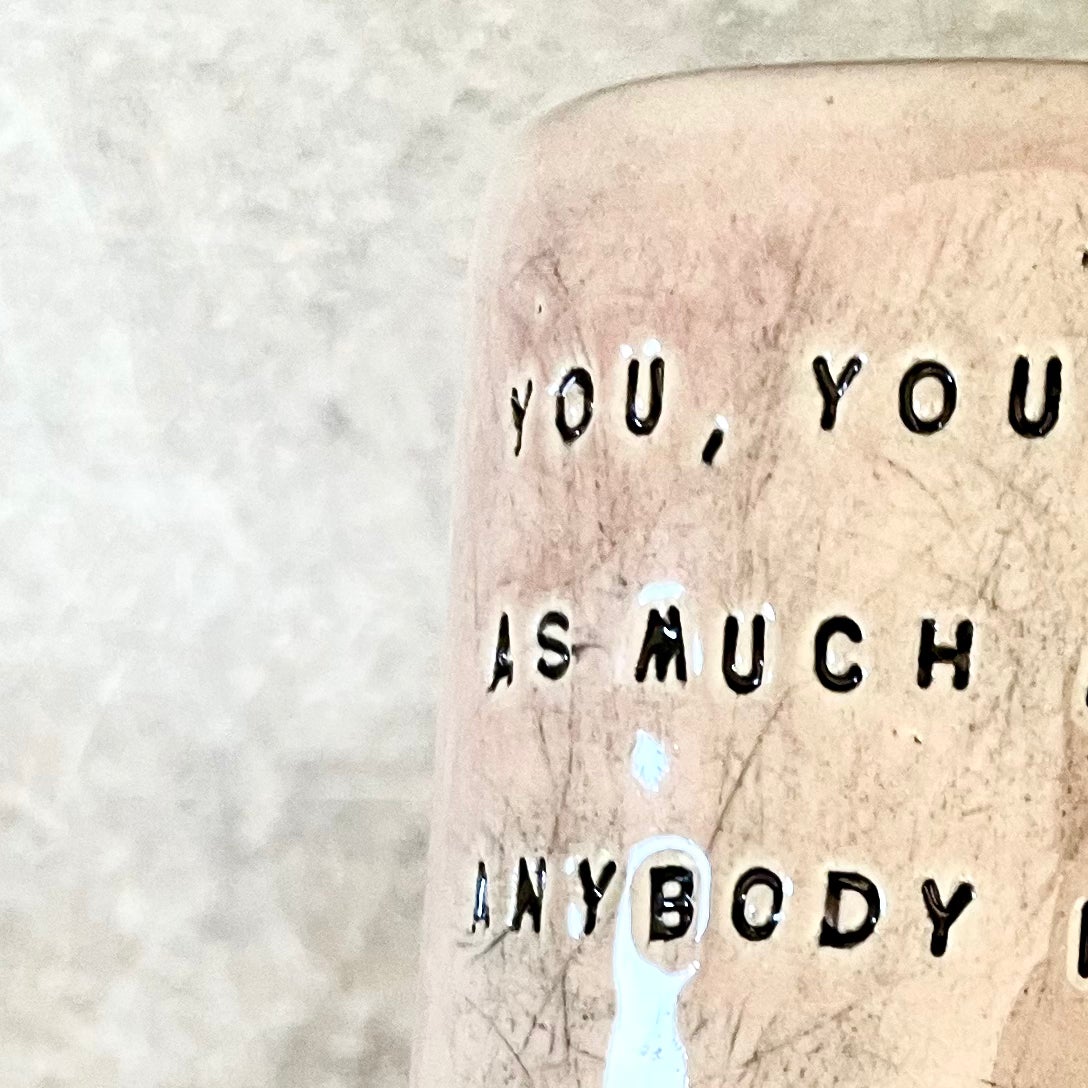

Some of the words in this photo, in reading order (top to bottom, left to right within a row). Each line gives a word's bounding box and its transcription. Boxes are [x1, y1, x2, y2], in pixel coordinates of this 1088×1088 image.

[487, 610, 571, 692] AS
[634, 605, 974, 694] MUCH
[472, 857, 976, 956] ANYBODY
